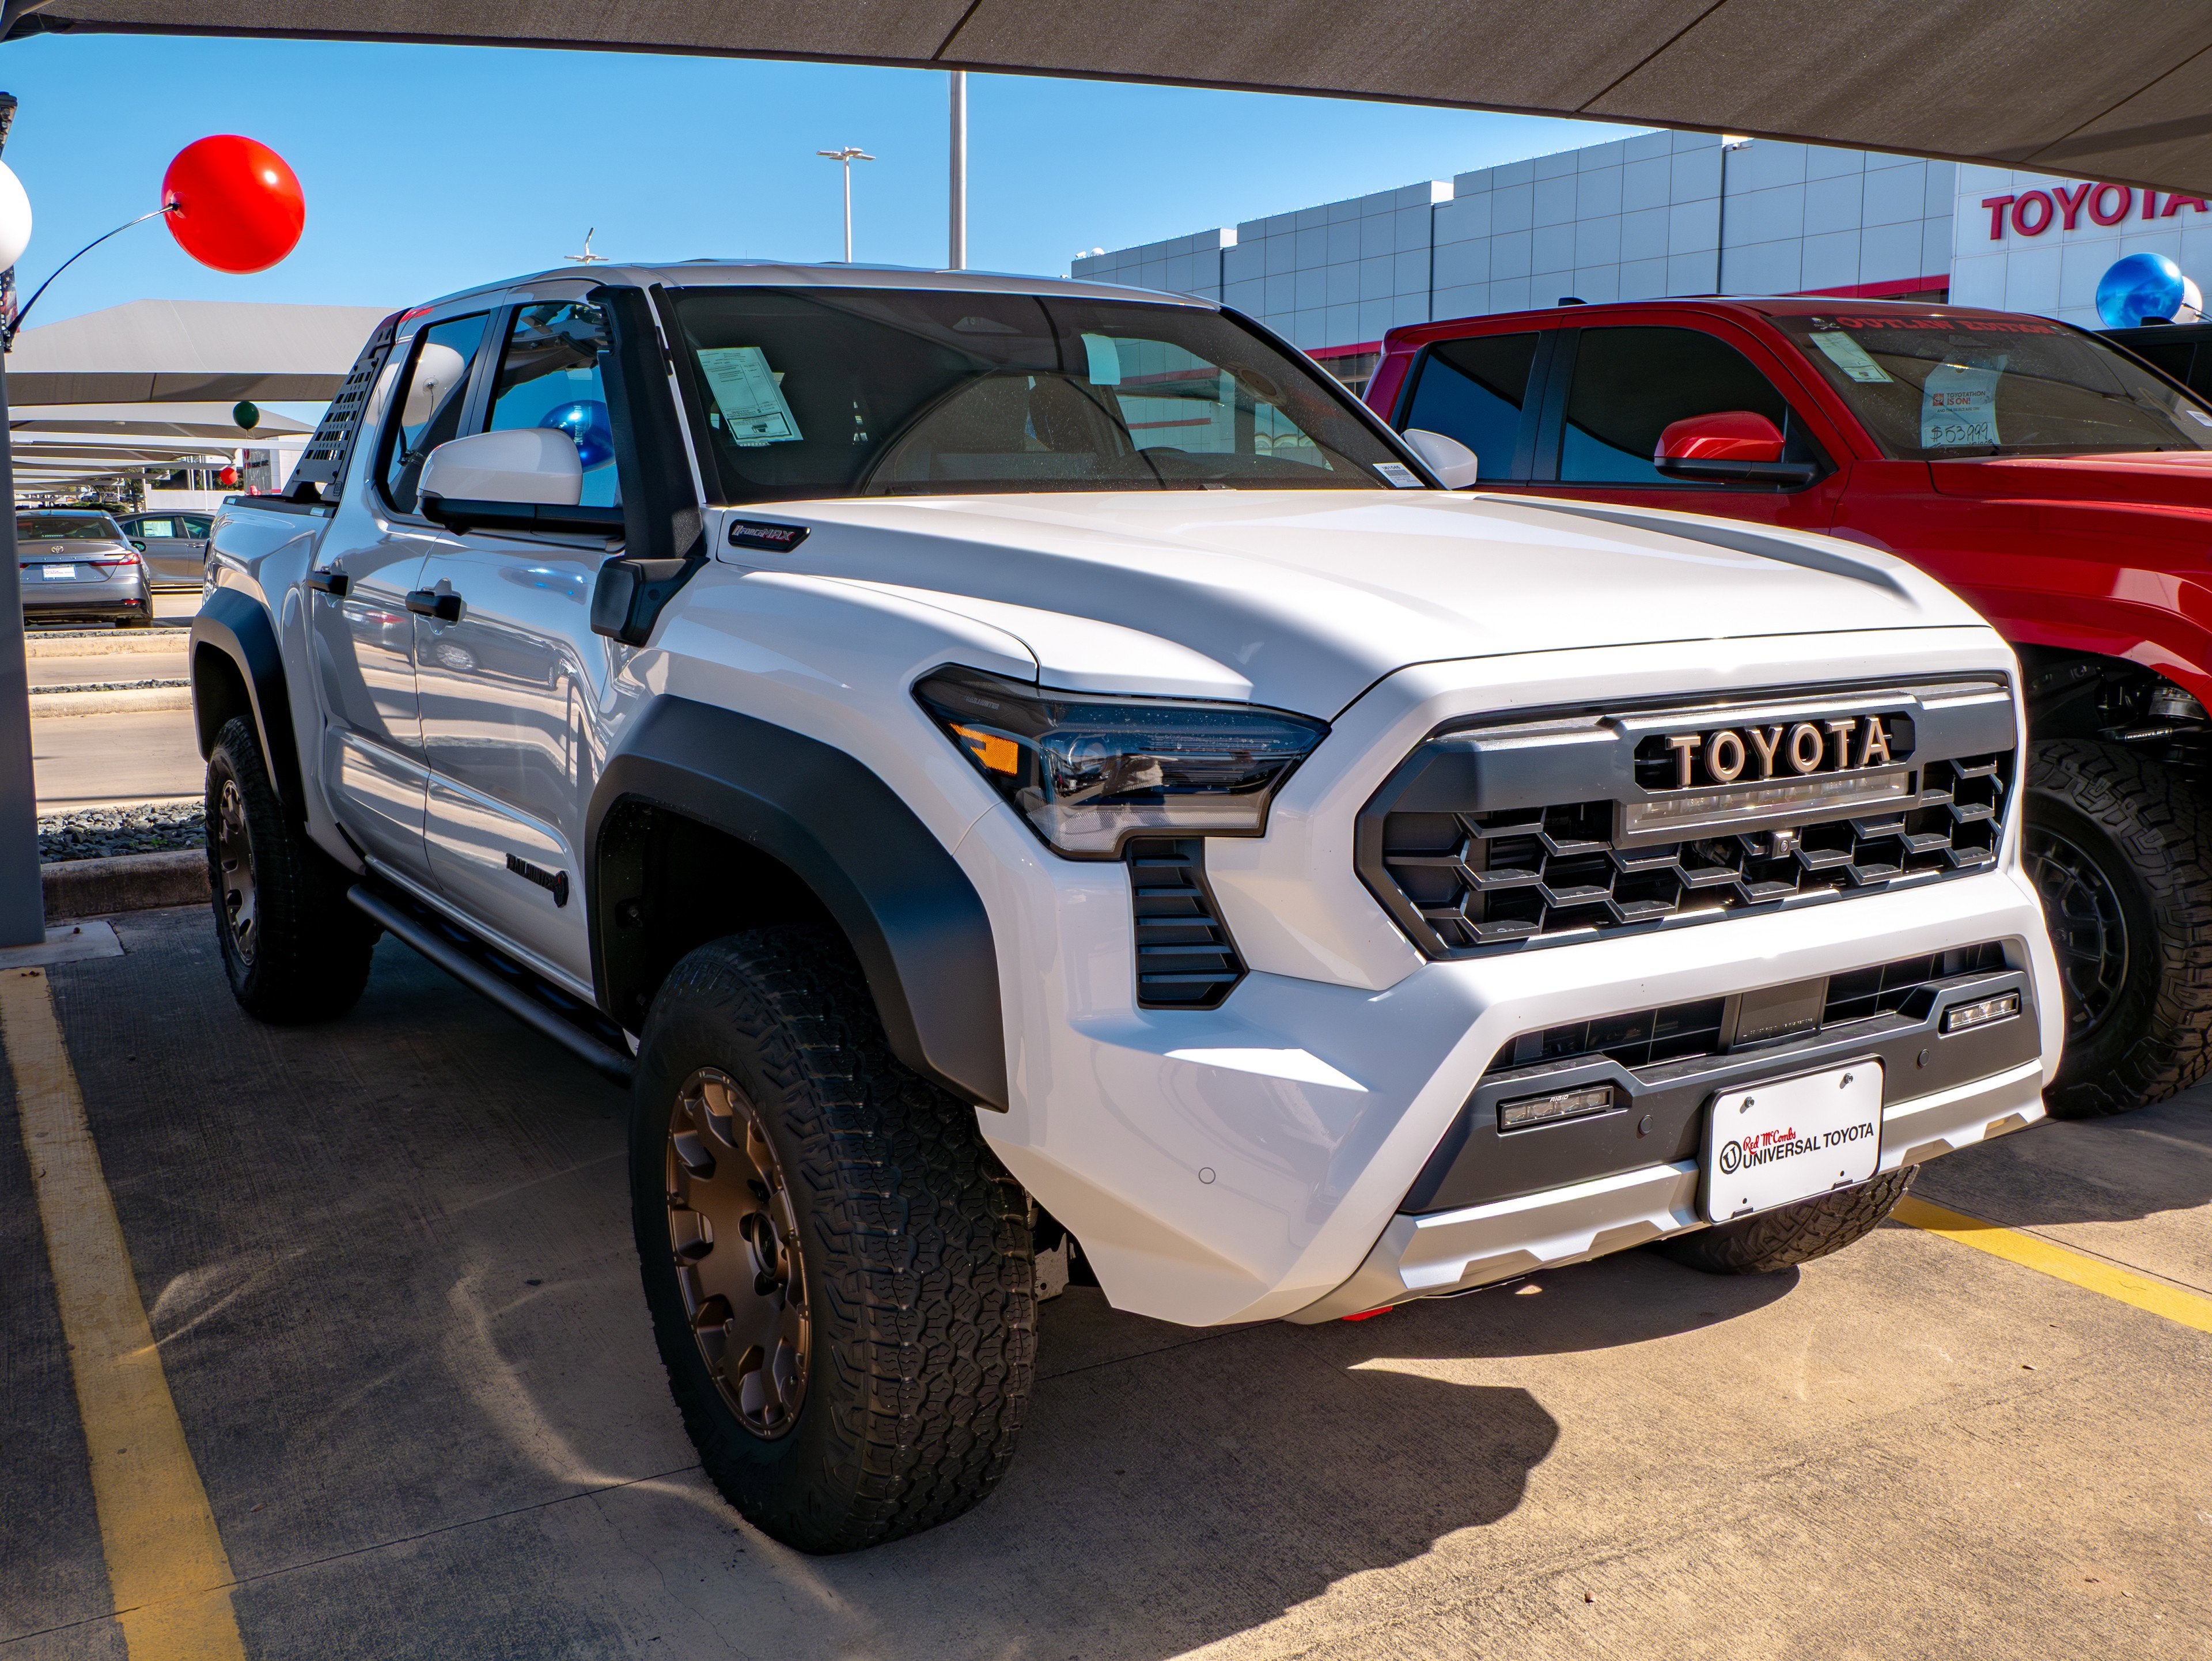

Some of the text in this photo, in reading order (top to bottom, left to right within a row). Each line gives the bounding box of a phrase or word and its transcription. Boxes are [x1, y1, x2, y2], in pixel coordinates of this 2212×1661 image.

[1666, 717, 1891, 789] TOYOTA
[1743, 1135, 1759, 1155] Red
[1743, 1136, 1821, 1169] UNIVERSAL
[1823, 1122, 1874, 1148] TOYOTA
